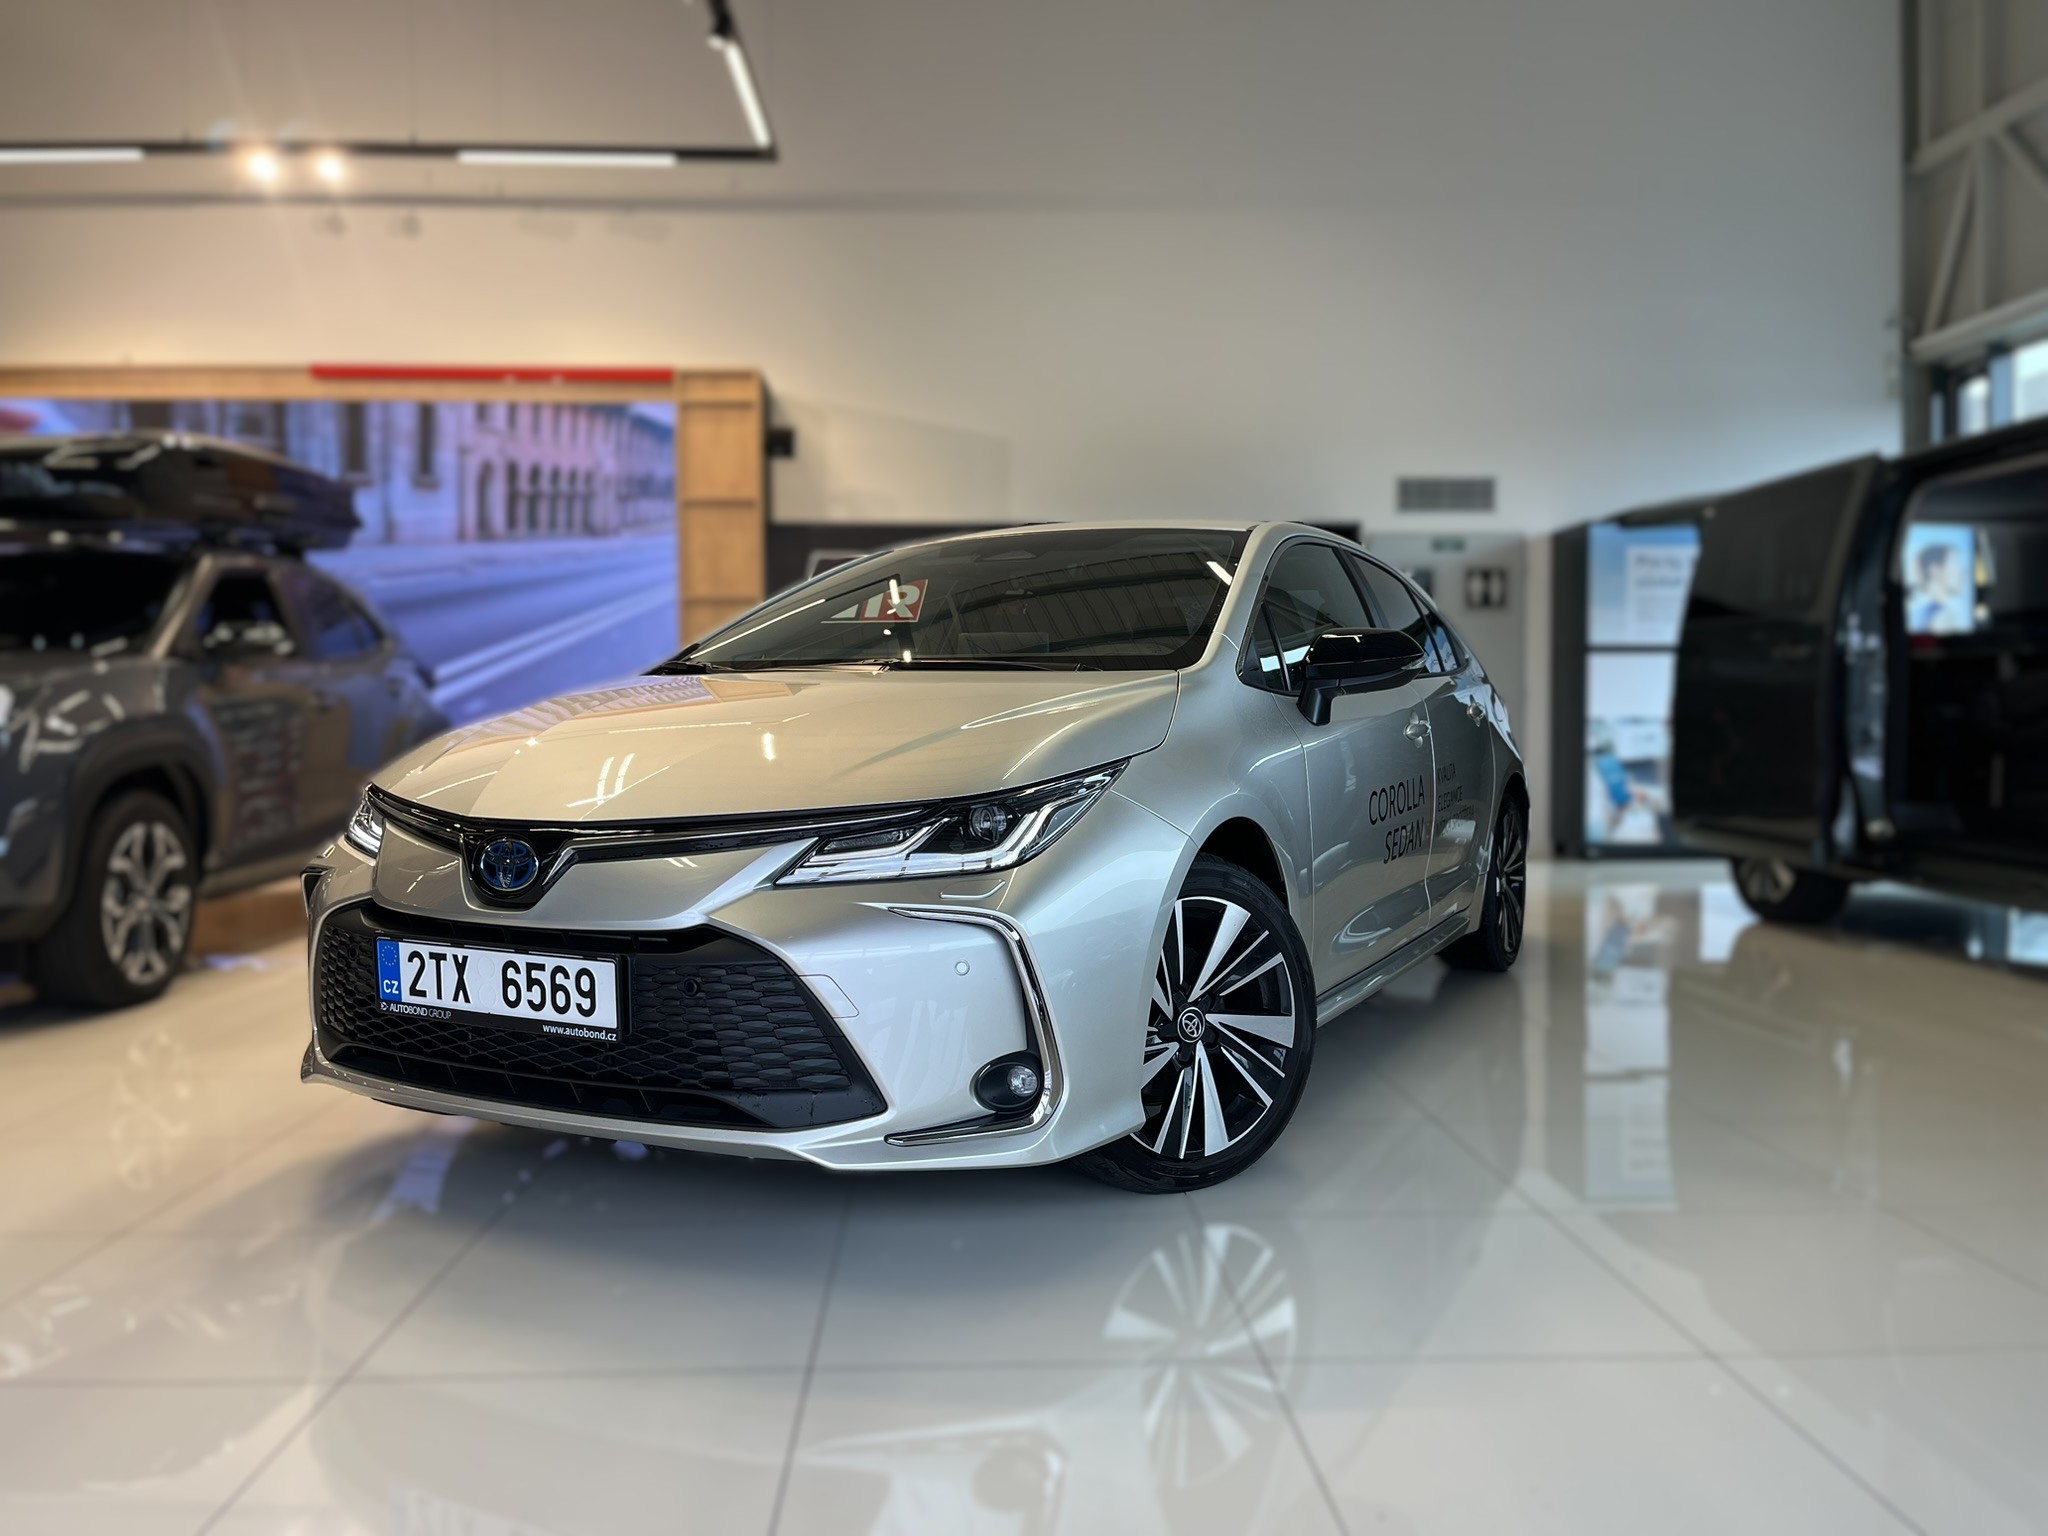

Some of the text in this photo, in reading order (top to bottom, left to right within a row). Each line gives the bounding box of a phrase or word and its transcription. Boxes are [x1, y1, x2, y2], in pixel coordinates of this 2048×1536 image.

[1369, 775, 1425, 826] COROLLA
[1383, 817, 1425, 864] SEDAN
[383, 979, 399, 994] CZ
[407, 950, 597, 1018] 2TX 6569
[389, 1003, 452, 1019] AUTOBOND GROUP
[542, 1024, 617, 1041] www.autobond.cz
